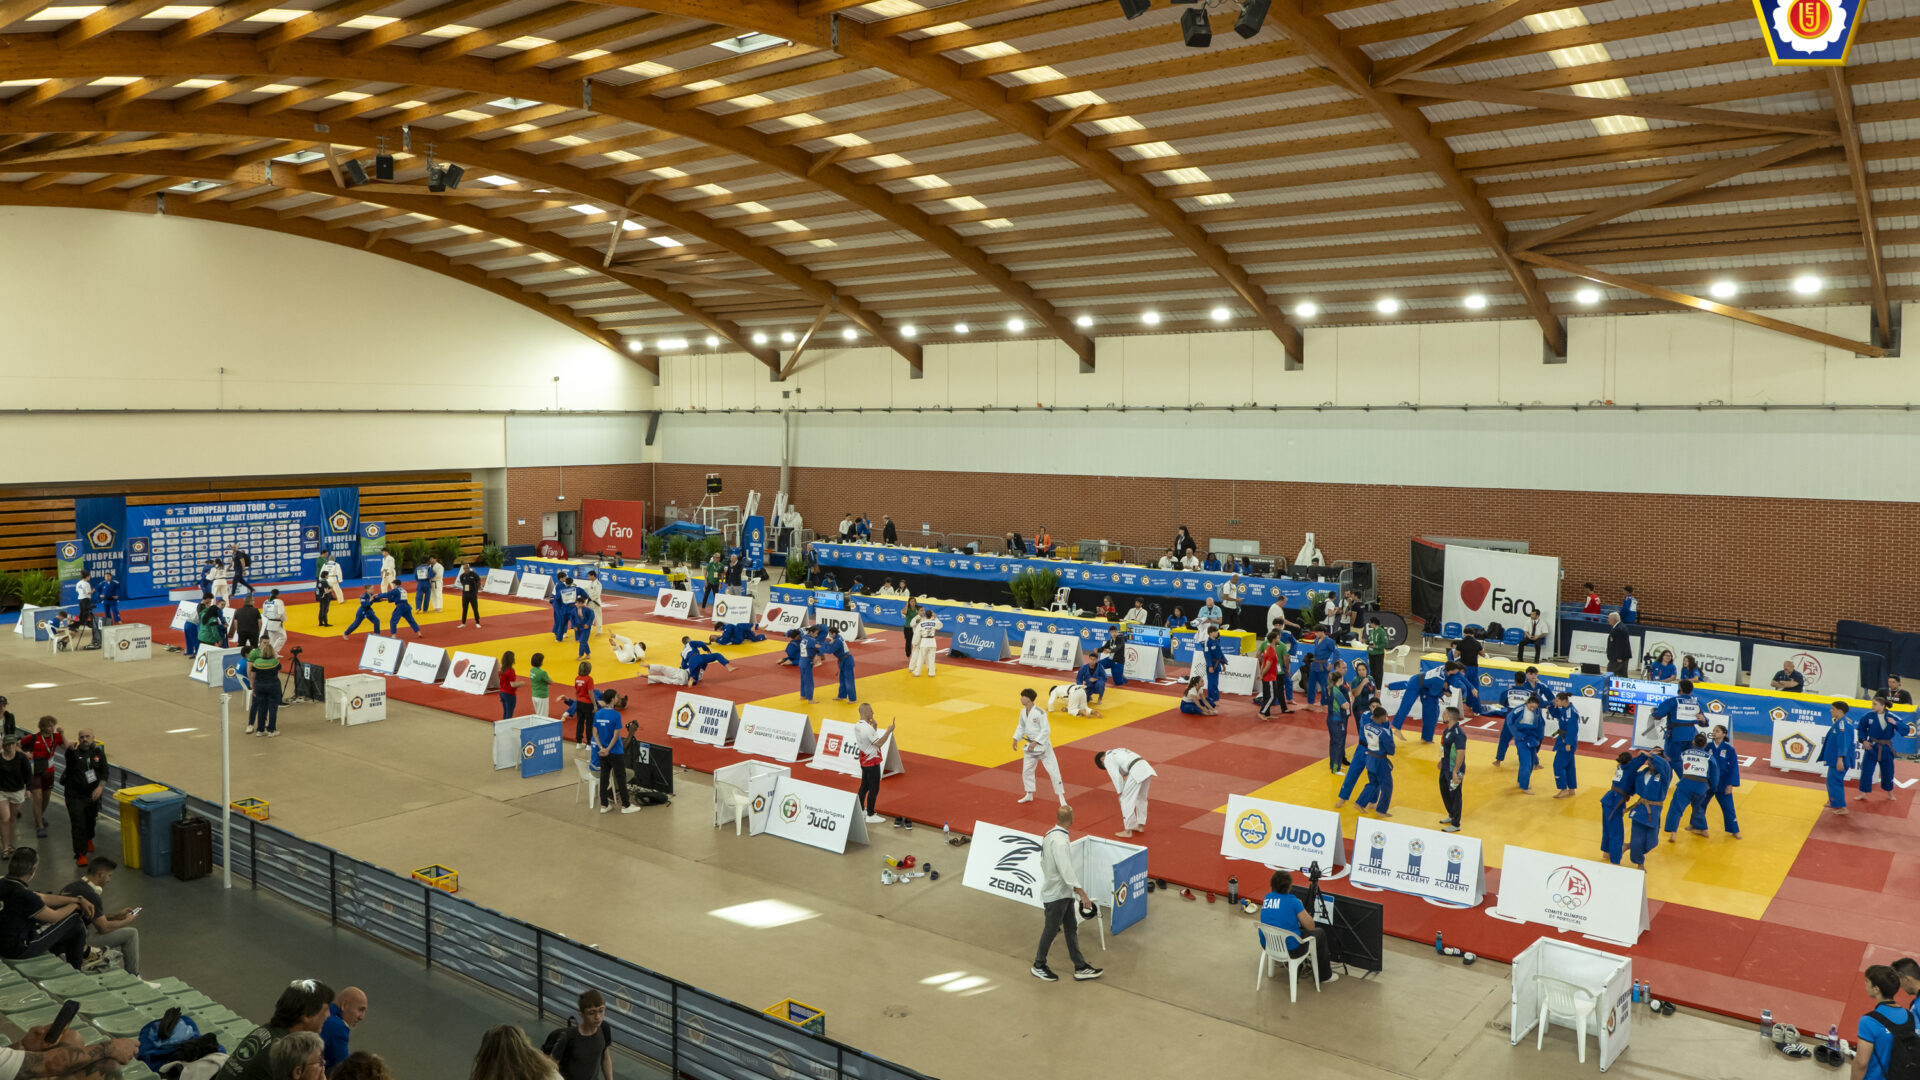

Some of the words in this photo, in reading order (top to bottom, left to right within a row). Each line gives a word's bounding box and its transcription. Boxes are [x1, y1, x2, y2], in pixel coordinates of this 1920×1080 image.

[189, 505, 226, 514] EUROPEAN
[228, 504, 246, 512] JUDO
[248, 503, 266, 512] TOUR
[247, 512, 277, 520] EUROPEAN
[609, 522, 633, 539] Faro
[324, 534, 356, 543] EUROPEAN
[548, 548, 558, 556] Faro
[671, 597, 687, 609] Faro
[1492, 588, 1537, 616] Faro
[779, 612, 799, 624] Faro
[822, 618, 848, 632] JUDO
[958, 632, 995, 652] Culligan
[1706, 653, 1734, 662] Portuguesa
[1698, 659, 1725, 673] udo
[466, 665, 486, 682] Faro
[698, 705, 728, 718] EUROPEAN
[1628, 704, 1635, 714] 3
[704, 717, 718, 726] JUDO
[700, 726, 718, 736] UNION
[642, 750, 647, 761] 2
[844, 741, 861, 760] trig
[808, 812, 836, 831] Judo
[1276, 826, 1325, 848] JUDO
[1301, 847, 1324, 855] ALGARVE
[1370, 858, 1381, 867] IJF
[1358, 865, 1391, 876] ACADEMY
[1408, 865, 1420, 875] IJF
[1396, 873, 1430, 884] ACADEMY
[1447, 872, 1459, 882] IJF
[989, 876, 1033, 898] ZEBRA
[1435, 881, 1469, 892] ACADEMY
[1262, 898, 1280, 909] EAM
[1557, 916, 1581, 925] PORTUGAL
